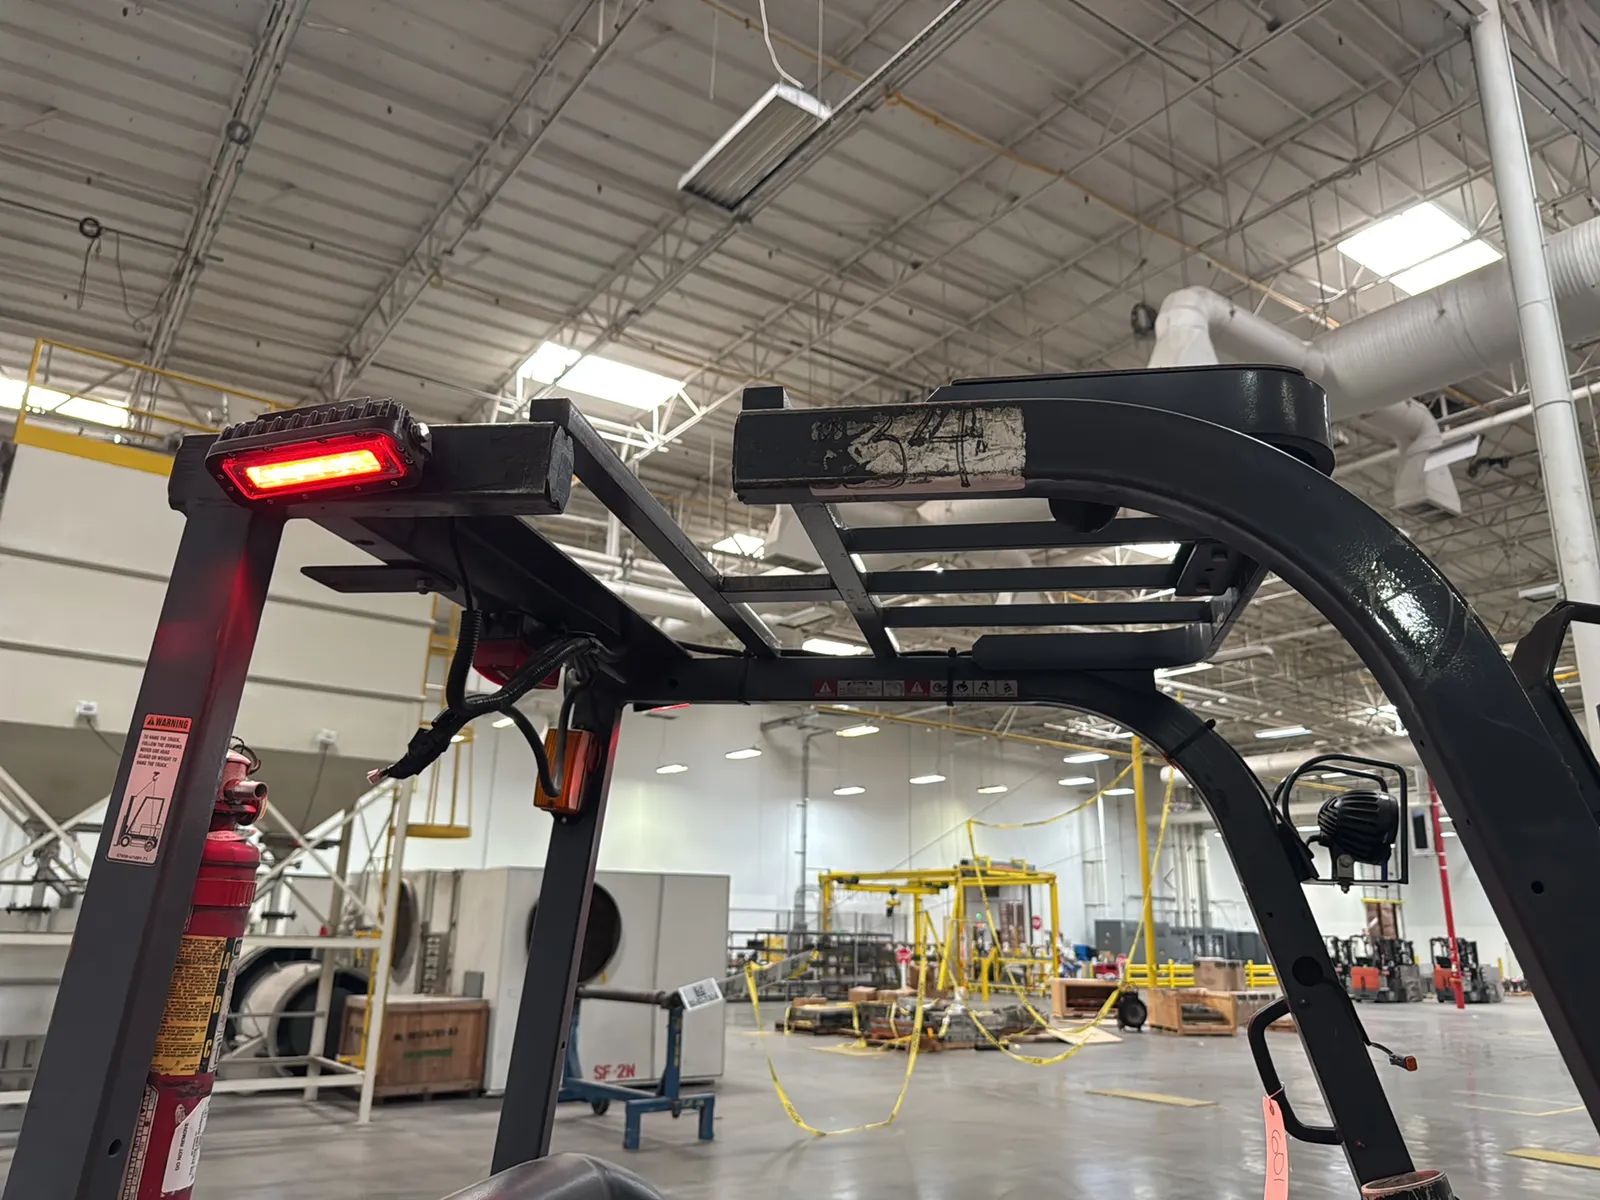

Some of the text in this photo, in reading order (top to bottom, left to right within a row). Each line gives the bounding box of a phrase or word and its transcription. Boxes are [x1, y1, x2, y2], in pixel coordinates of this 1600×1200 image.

[155, 717, 189, 729] WARNING
[222, 952, 231, 970] A
[212, 995, 222, 1014] B
[203, 1039, 213, 1058] C
[180, 1122, 190, 1148] REMOVE
[176, 1149, 184, 1161] NOT
[174, 1161, 181, 1172] DO
